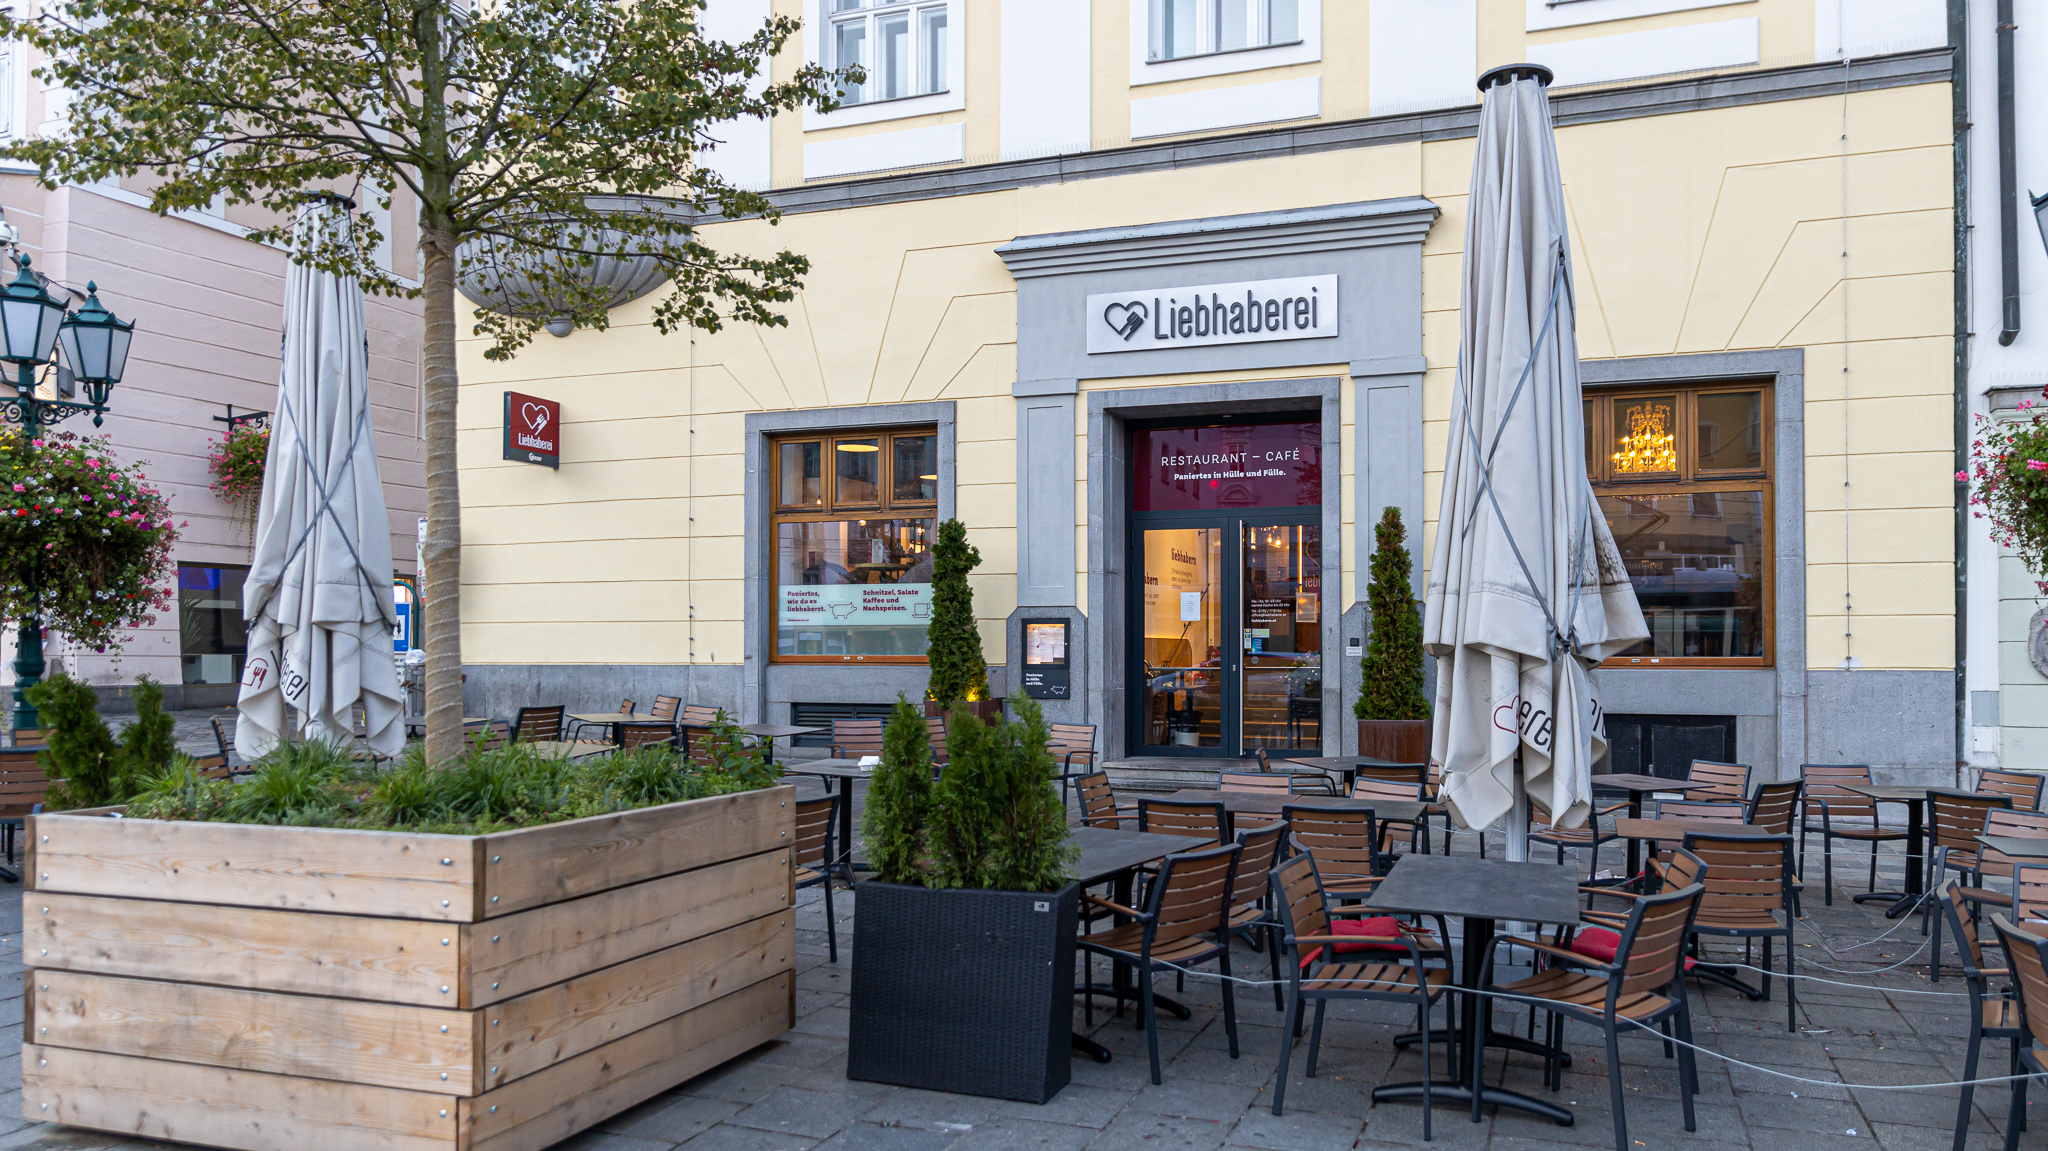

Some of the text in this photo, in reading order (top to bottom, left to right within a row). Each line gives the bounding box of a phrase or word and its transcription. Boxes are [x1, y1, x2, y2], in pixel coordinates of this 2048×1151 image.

[1154, 286, 1318, 340] Liebhaberei
[518, 432, 553, 451] Liebhaberei
[1161, 452, 1248, 467] RESTAURANT
[1265, 447, 1300, 462] CAFÉ
[1174, 468, 1286, 481] Paniertes in Hülle und Fülle.
[787, 590, 820, 598] Paniertes,
[862, 589, 896, 597] Schnitzel,
[862, 605, 908, 613] Nachspeisen.
